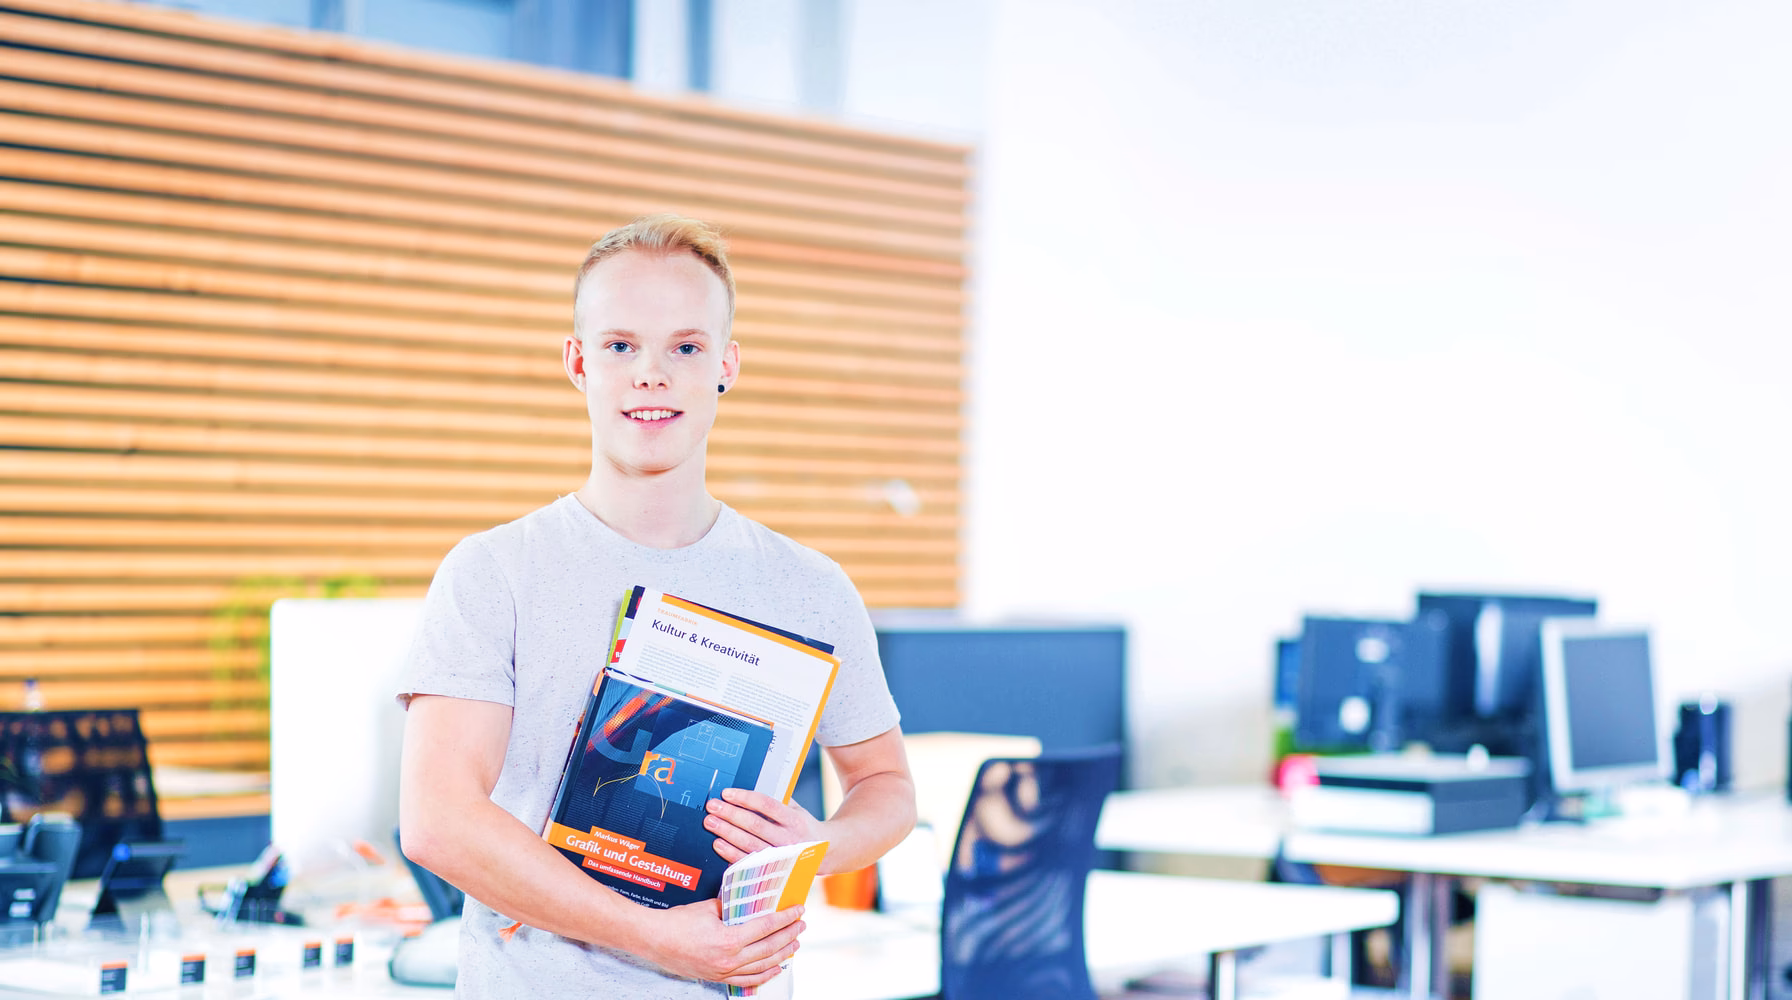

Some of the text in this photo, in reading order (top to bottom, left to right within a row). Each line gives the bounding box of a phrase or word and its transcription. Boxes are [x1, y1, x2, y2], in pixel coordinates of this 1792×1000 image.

[652, 619, 760, 666] Kultur & Kreativität
[594, 831, 619, 844] Markus
[566, 835, 692, 886] Grafik und Gestaltung
[588, 859, 661, 888] Das umfassende Handbuch
